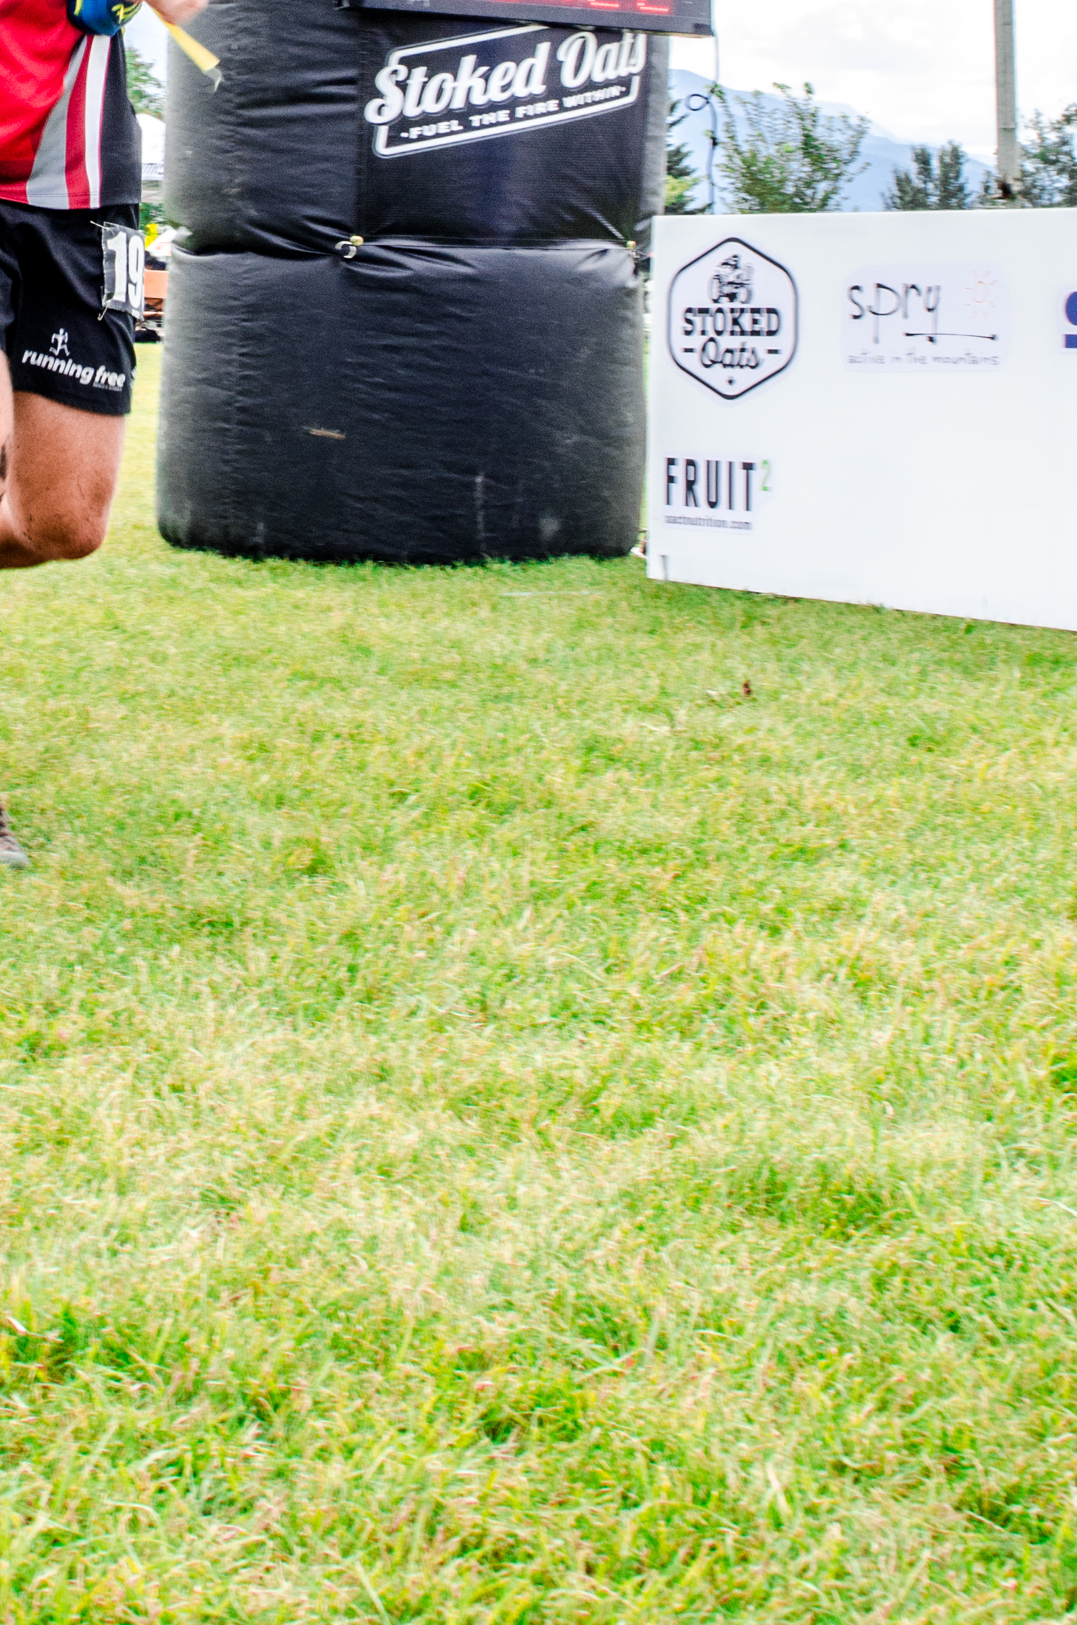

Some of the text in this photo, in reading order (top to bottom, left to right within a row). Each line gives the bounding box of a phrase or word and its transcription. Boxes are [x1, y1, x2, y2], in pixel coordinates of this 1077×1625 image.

[364, 31, 647, 123] Stoked Oats
[469, 110, 510, 127] THE
[515, 99, 559, 118] FIRE
[682, 307, 781, 337] STOKED
[848, 283, 941, 345] spry
[22, 350, 126, 388] running free
[700, 336, 762, 369] Oats
